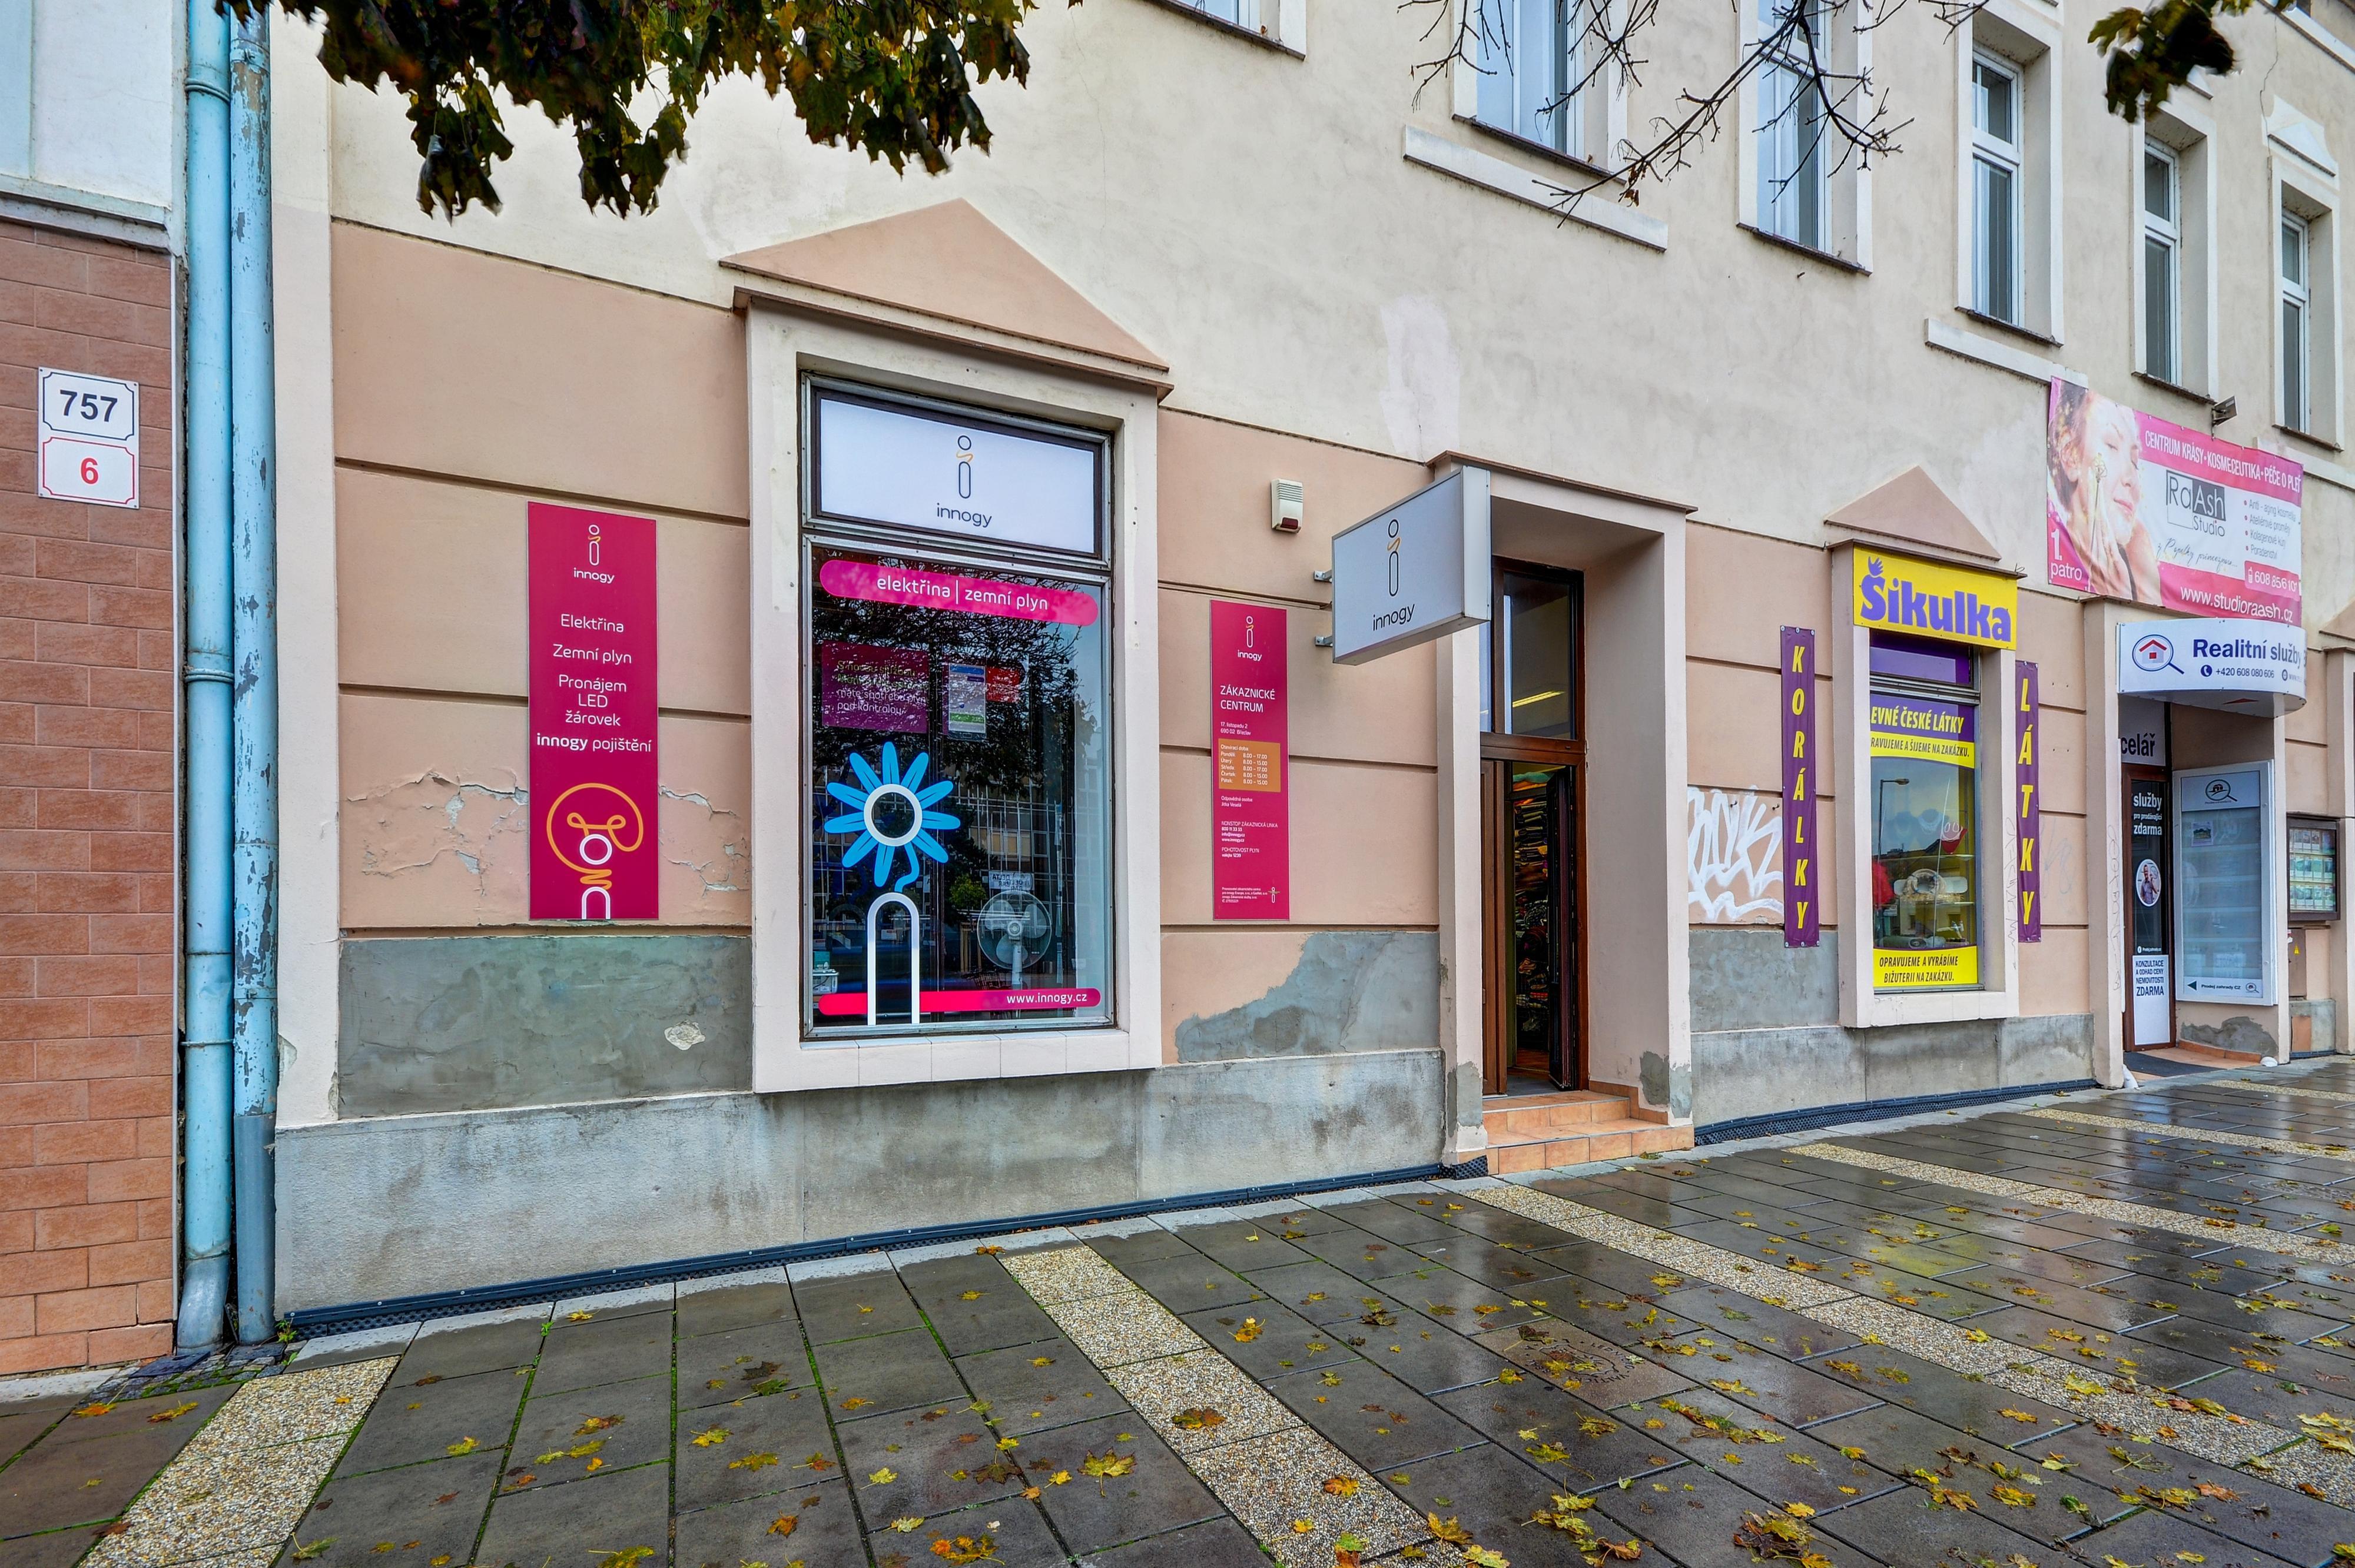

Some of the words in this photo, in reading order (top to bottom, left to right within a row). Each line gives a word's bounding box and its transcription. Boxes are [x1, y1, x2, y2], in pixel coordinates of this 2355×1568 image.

[59, 390, 118, 422] 757
[2145, 430, 2180, 456] CENTRUM
[2182, 442, 2204, 464] KRÁSY
[2207, 451, 2261, 480] KOSMECEUTIKA
[2264, 465, 2280, 487] PÉČE
[2282, 476, 2286, 487] O
[80, 458, 99, 484] 6
[2170, 476, 2224, 519] RaAsh
[937, 503, 992, 528] innogy
[2250, 499, 2259, 510] Anti
[2264, 504, 2276, 517] aging
[2194, 516, 2225, 537] Studio
[2251, 530, 2277, 544] Kolagenové
[573, 567, 615, 583] innogy
[2051, 563, 2082, 581] patro
[2254, 571, 2270, 585] 608
[2272, 576, 2287, 589] 856
[877, 575, 951, 599] elektřina
[964, 589, 1011, 606] zemní
[1016, 596, 1048, 611] plyn
[1860, 556, 2011, 642] Šikulka
[2181, 587, 2293, 623] www.studioraash.cz
[560, 613, 624, 632] Elektřina
[1373, 604, 1415, 631] innogy
[553, 644, 599, 661] Zemní
[603, 650, 632, 665] plyn
[1238, 650, 1262, 662] innogy
[2193, 639, 2267, 659] Realitní
[2271, 643, 2301, 669] služby
[2216, 667, 2235, 676] +420
[2237, 668, 2250, 676] 608
[2251, 669, 2263, 677] 080
[2264, 670, 2274, 678] 606
[559, 675, 626, 693] Pronájem
[1220, 684, 1275, 700] ZÁKAZNICKÉ
[578, 693, 608, 707] LED
[1220, 700, 1263, 712] CENTRUM
[565, 710, 621, 726] žárovek
[1900, 706, 1932, 730] ČESKÉ
[1933, 711, 1964, 733] LÁTKY
[537, 733, 588, 751] innogy
[593, 738, 652, 753] pojištění
[1910, 742, 1931, 753] ŠIJEME
[1941, 744, 1969, 757] ZAKÁZKU.
[2121, 733, 2155, 756] celář
[1792, 645, 1809, 929] KORÁLKY
[2018, 678, 2035, 925] LÁTKY
[2134, 792, 2162, 811] služby
[2134, 822, 2162, 835] zdarma
[1879, 956, 1921, 967] OPRAVUJEME
[1922, 957, 1926, 966] A
[1928, 954, 1958, 966] VYRÁBÍME
[1884, 971, 1915, 983] BIŽUTERII
[1916, 972, 1924, 982] NA
[1926, 969, 1954, 981] ZAKÁZKU.
[1006, 991, 1087, 1004] www.innogy.cz
[2137, 986, 2164, 996] ZDARMA
